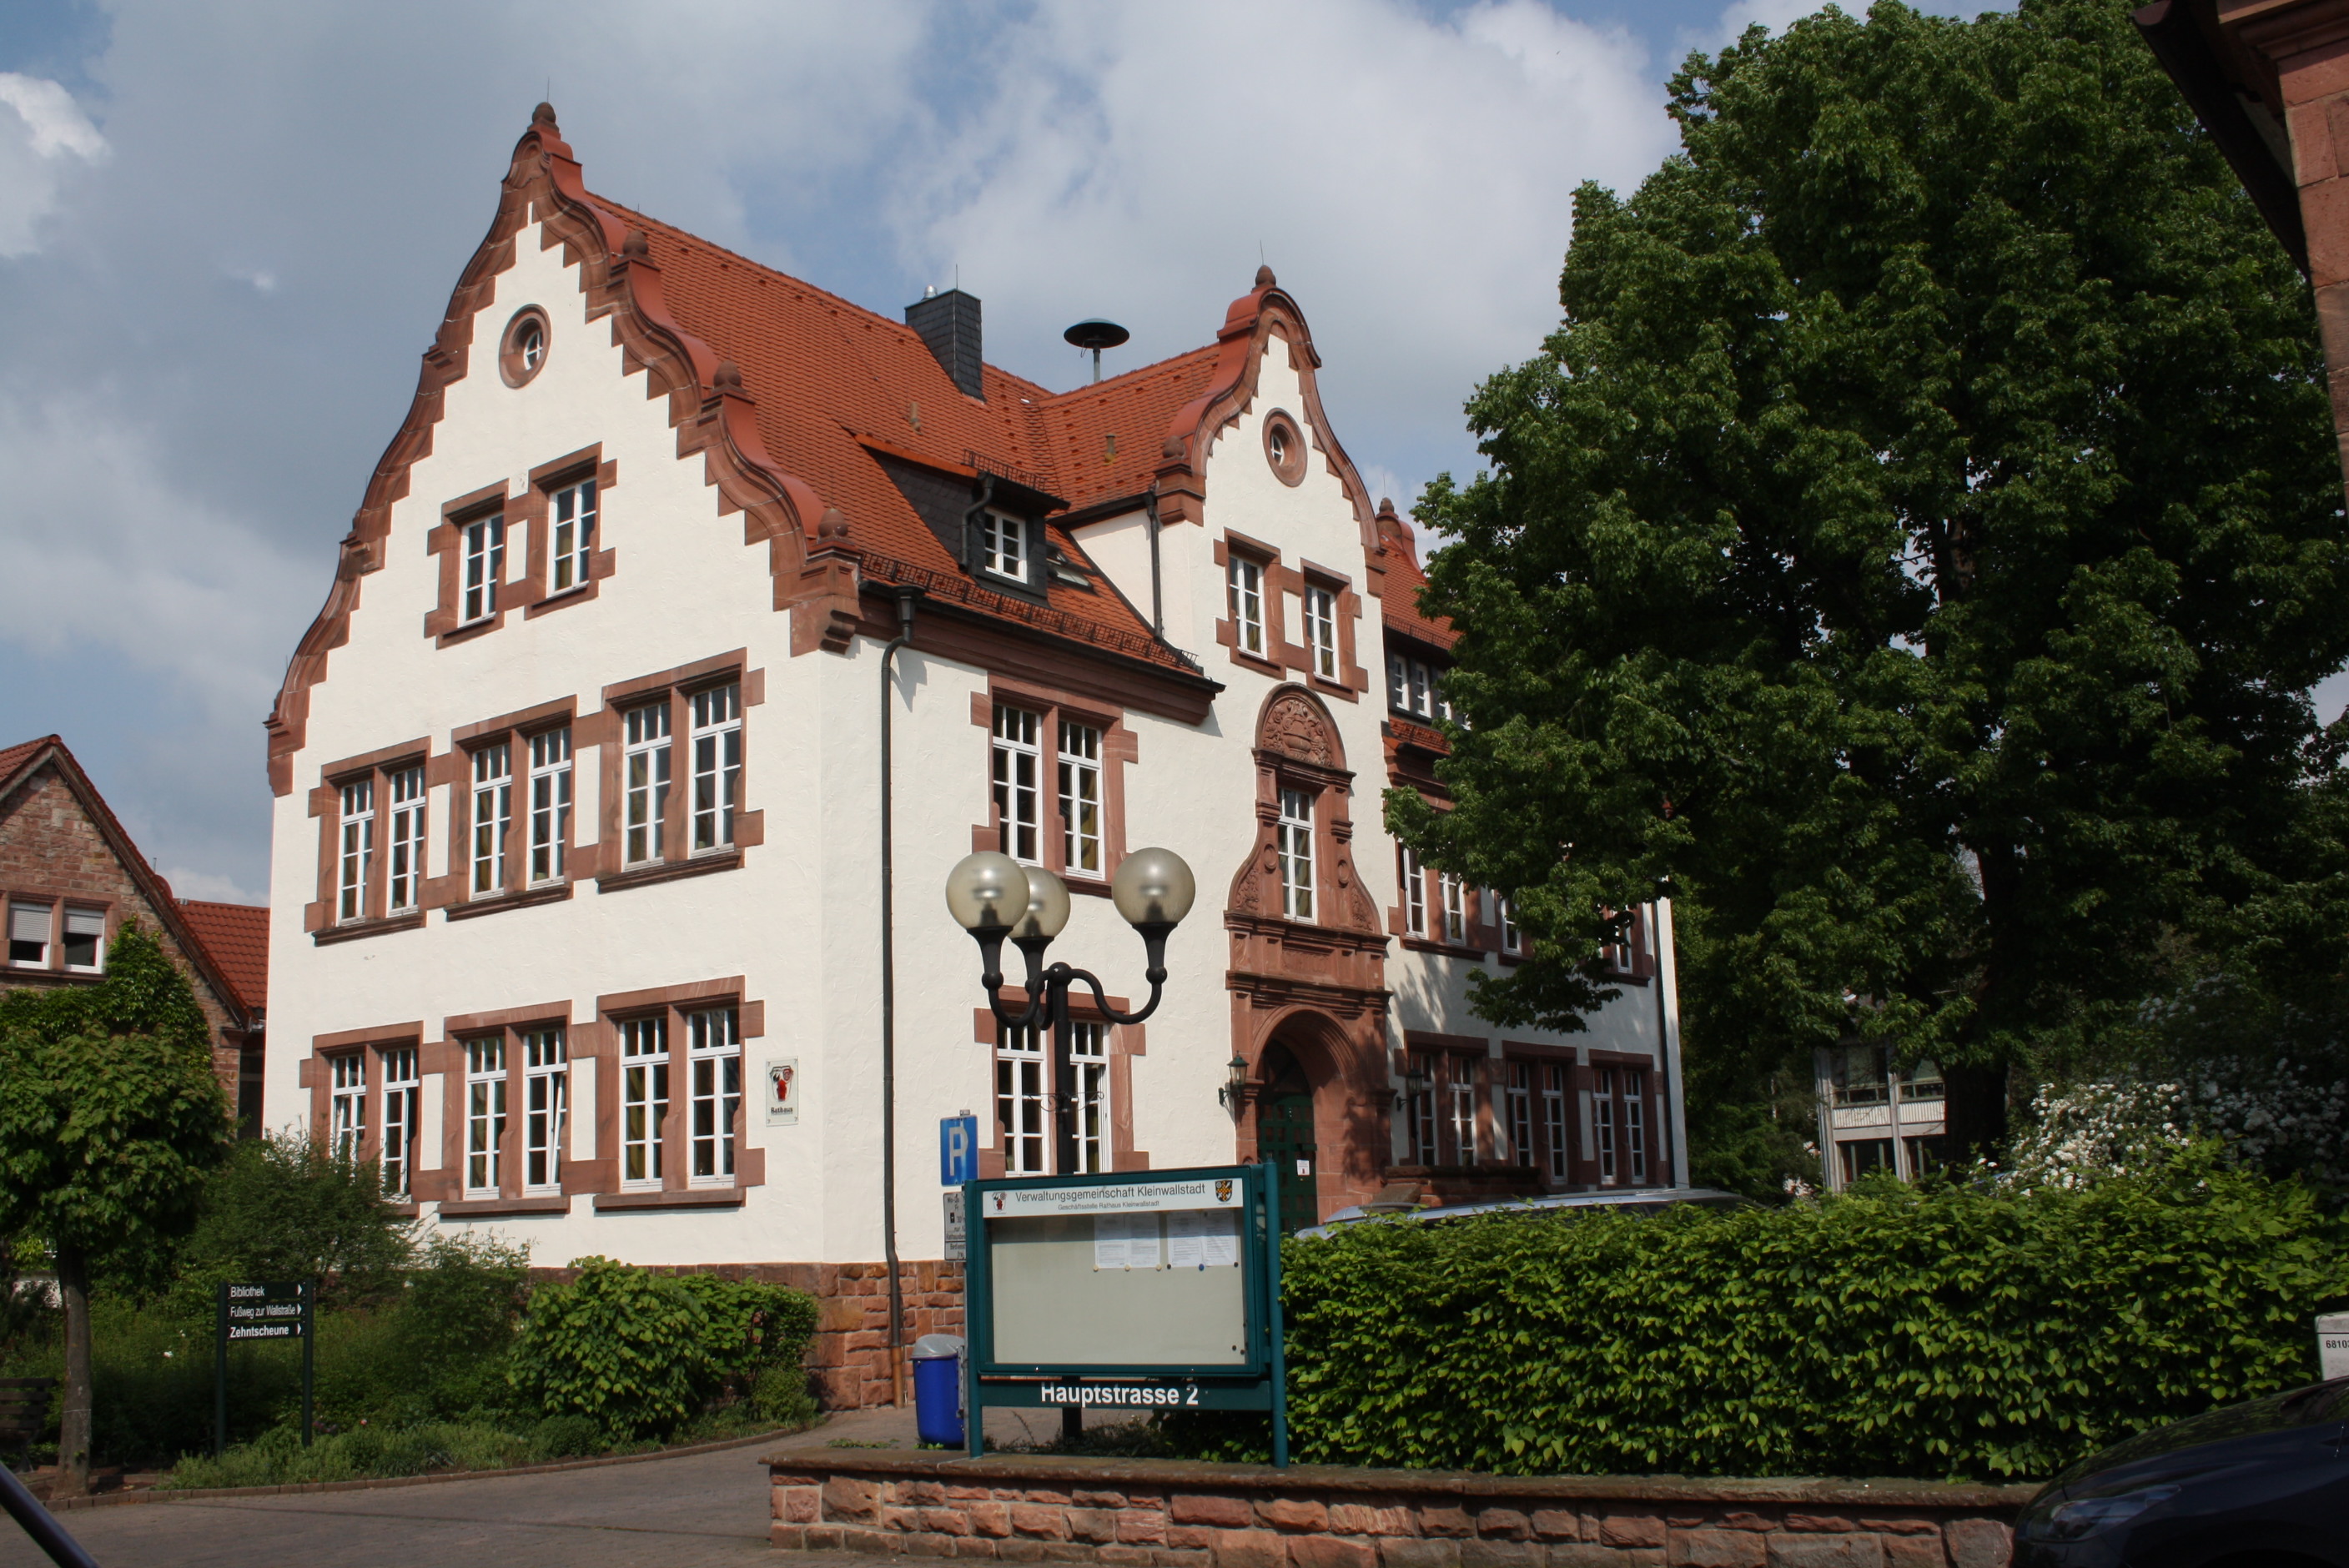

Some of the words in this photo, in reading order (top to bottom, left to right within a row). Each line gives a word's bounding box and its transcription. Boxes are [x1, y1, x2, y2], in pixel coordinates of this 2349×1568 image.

[949, 1127, 968, 1176] P
[1015, 1186, 1134, 1203] Verwaltungsgemeinschaft
[1137, 1184, 1205, 1197] Kleinwallstadt
[1058, 1202, 1098, 1211] Geschäftsstelle
[1099, 1201, 1121, 1209] Rathaus
[1123, 1199, 1159, 1209] Kleinwallstadt
[230, 1286, 264, 1297] Bibliothek
[230, 1306, 254, 1319] Fußweg
[255, 1307, 265, 1316] zur
[266, 1304, 295, 1316] Wallstraße
[230, 1324, 289, 1338] Zehntscheune
[1041, 1381, 1180, 1408] Hauptstrasse
[1185, 1383, 1199, 1405] 2
